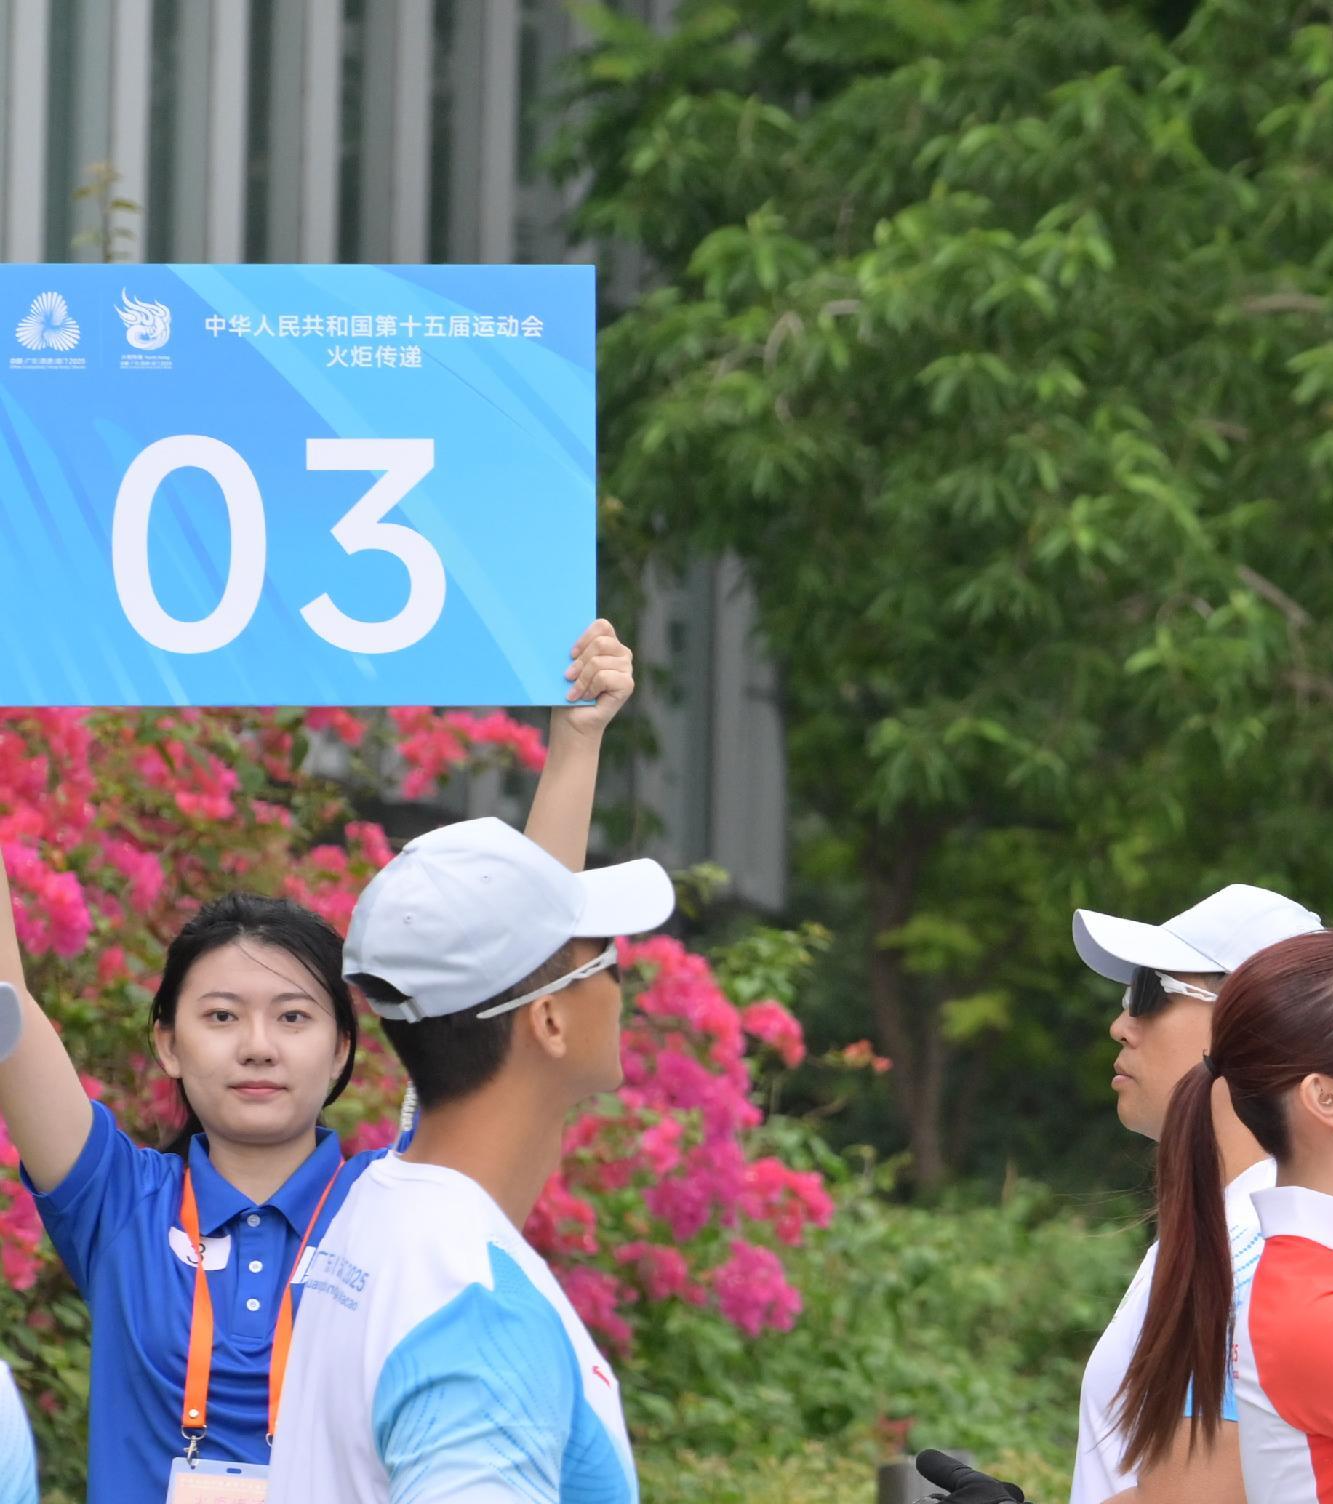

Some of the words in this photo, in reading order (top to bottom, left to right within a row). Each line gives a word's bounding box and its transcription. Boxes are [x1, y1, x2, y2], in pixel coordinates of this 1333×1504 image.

[204, 314, 544, 339] 中华人民共和国第十五届运动会
[326, 346, 423, 368] 火炬传递
[112, 434, 446, 654] 03
